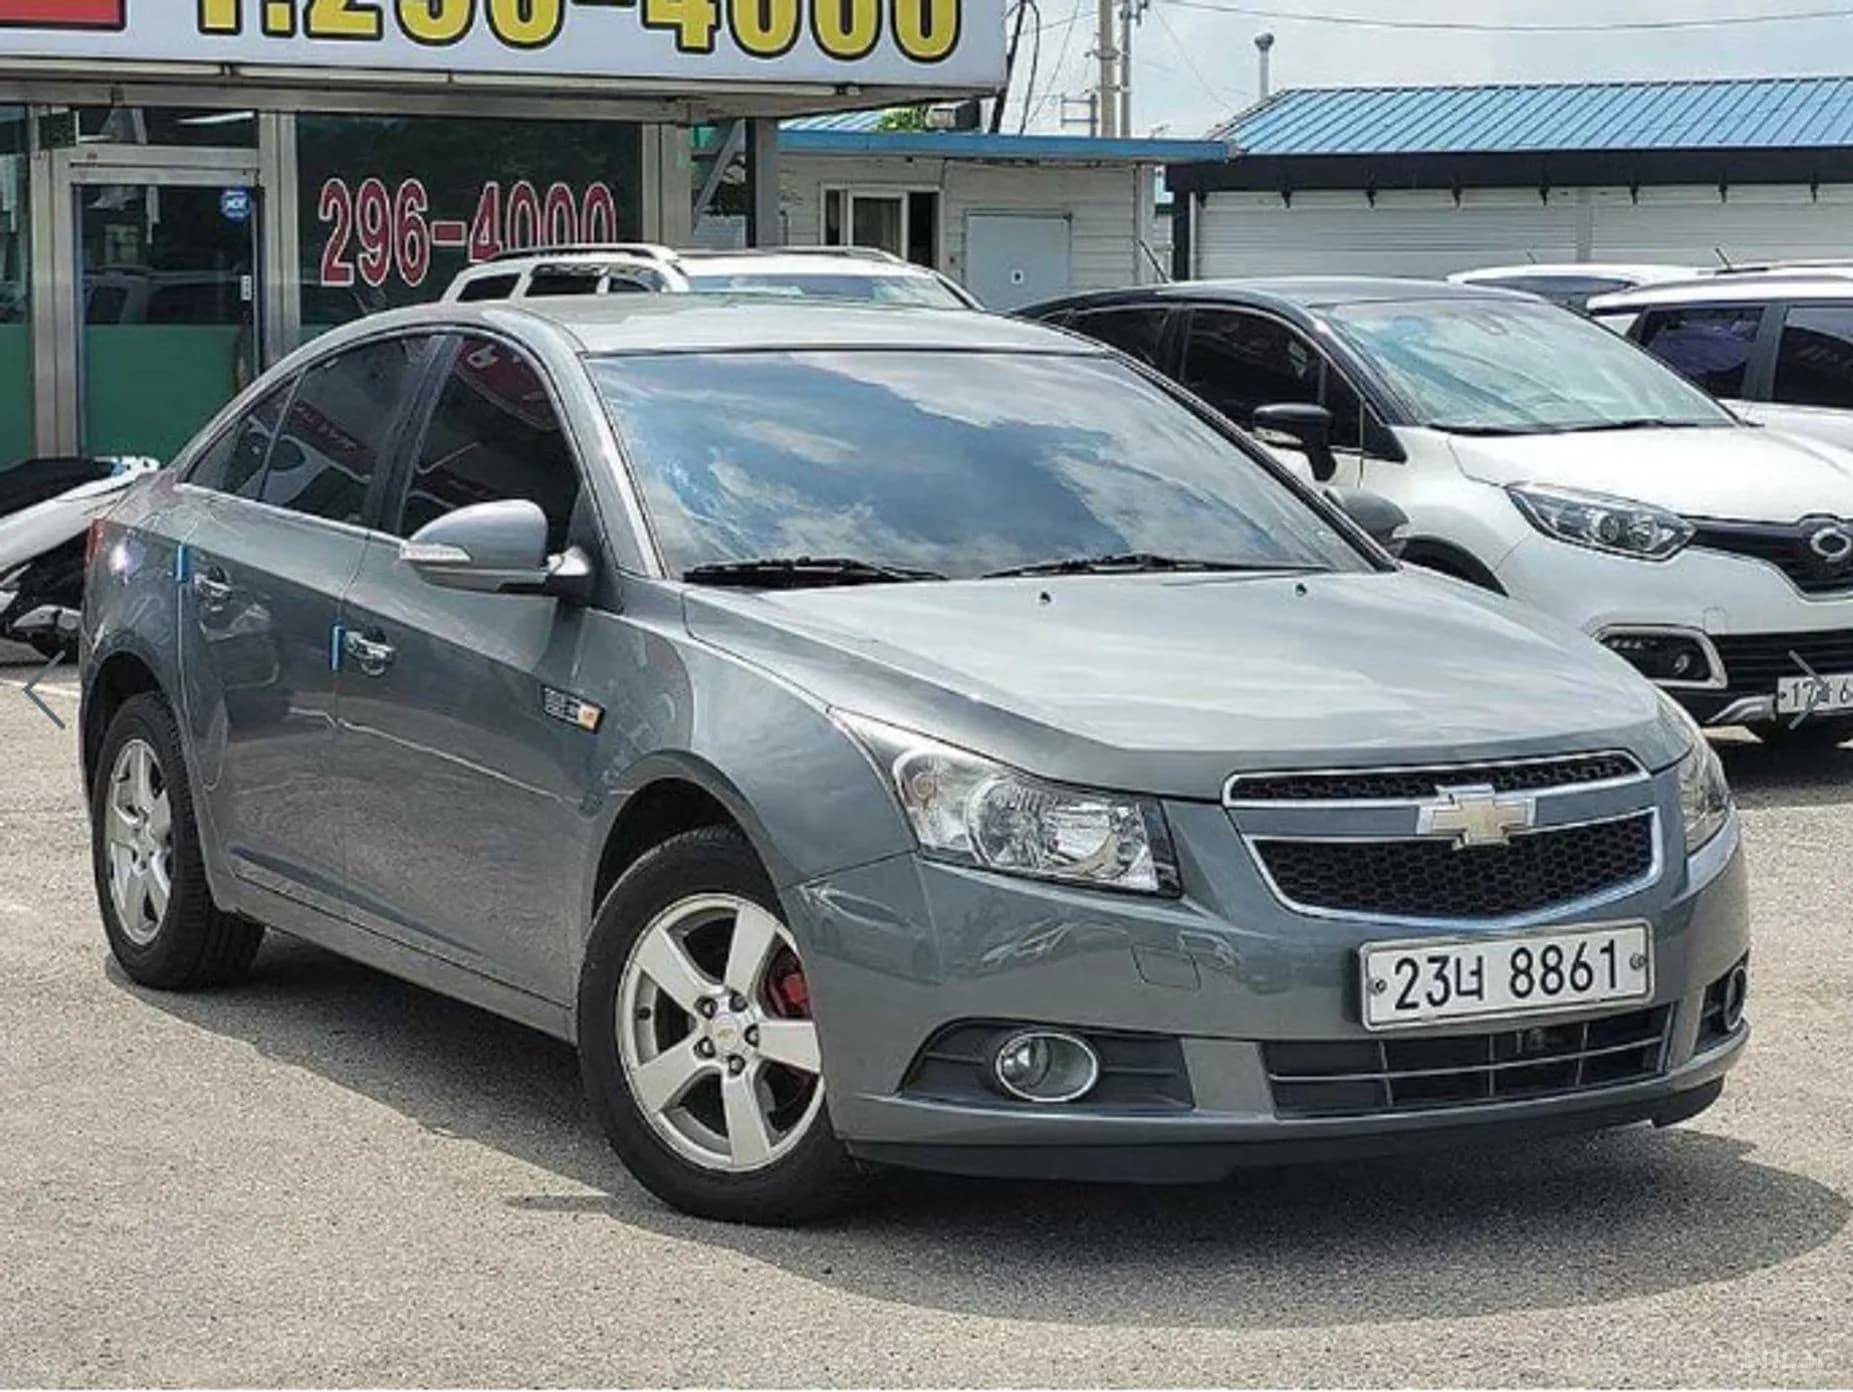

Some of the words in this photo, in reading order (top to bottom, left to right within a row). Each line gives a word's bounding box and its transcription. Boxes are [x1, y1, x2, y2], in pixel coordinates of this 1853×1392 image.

[318, 177, 617, 287] 296-4000
[1394, 955, 1485, 1011] 23너
[1509, 939, 1618, 999] 8861
